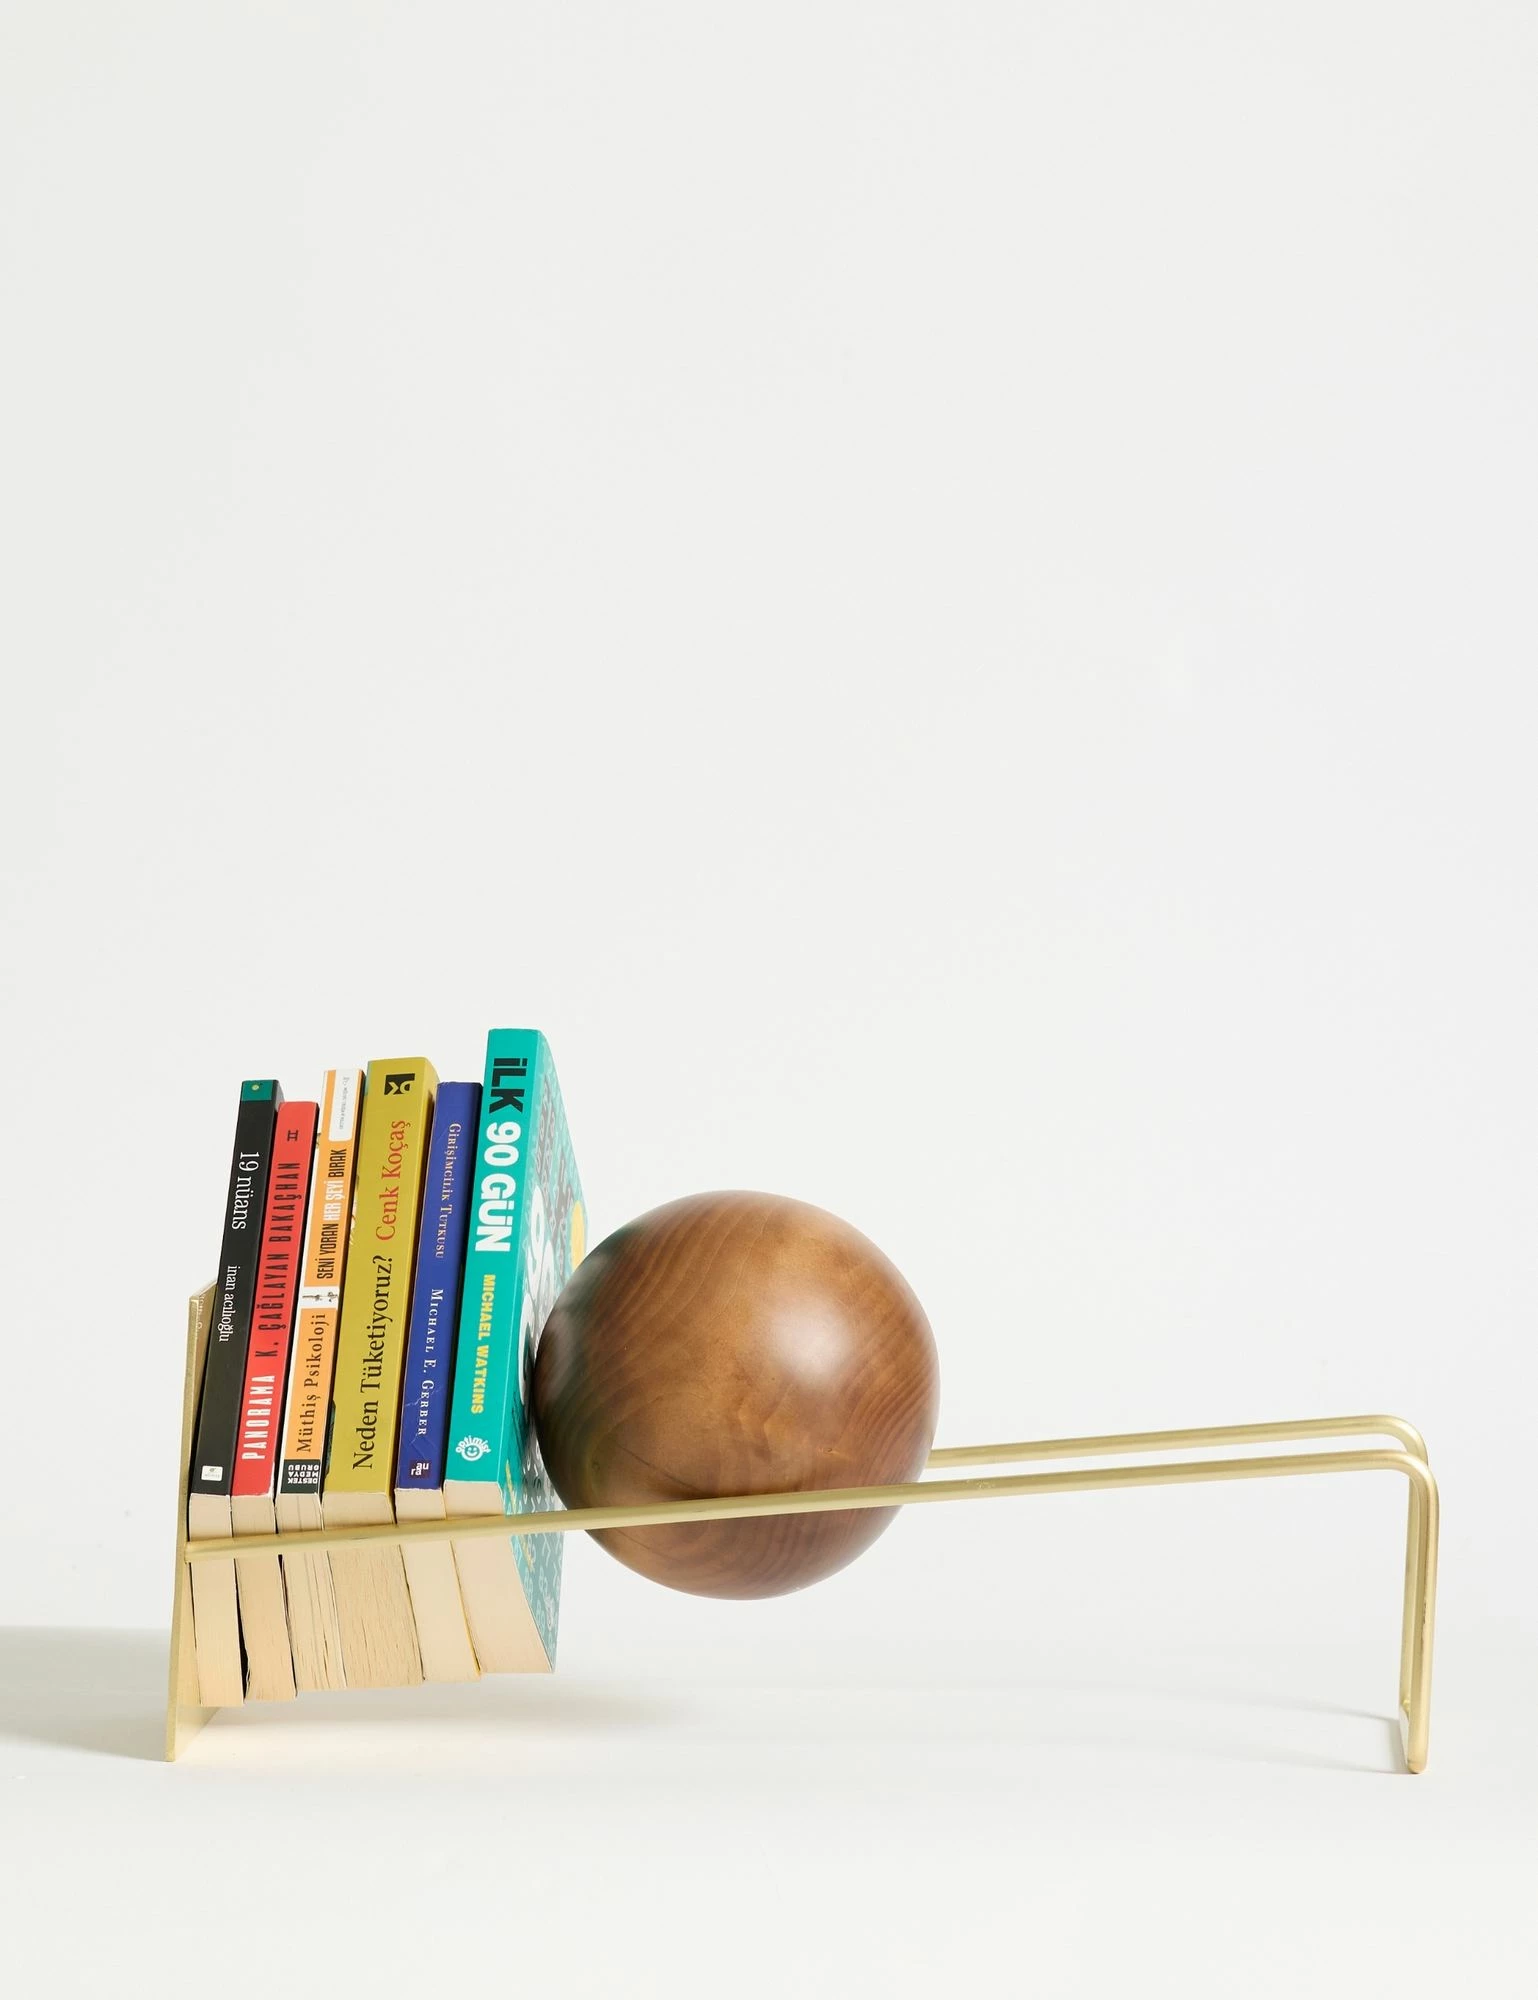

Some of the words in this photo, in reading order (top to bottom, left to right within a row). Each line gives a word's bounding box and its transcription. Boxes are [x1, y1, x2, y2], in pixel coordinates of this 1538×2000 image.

[239, 1152, 260, 1171] 19
[287, 1130, 299, 1142] II
[328, 1148, 347, 1178] BIRAK
[381, 1120, 411, 1180] Koçaş
[484, 1122, 521, 1166] 90
[232, 1176, 254, 1230] nüans
[269, 1163, 302, 1242] BAKAÇHAN
[323, 1202, 341, 1222] HER
[325, 1180, 345, 1200] ŞEYİ
[375, 1186, 400, 1241] Cenk
[475, 1173, 516, 1252] GÜN
[319, 1223, 339, 1256] YORAN
[226, 1265, 241, 1291] inan
[257, 1253, 289, 1330] ÇAĞLAYAN
[315, 1258, 335, 1279] SENİ
[360, 1255, 393, 1393] Tüketiyoruz?
[478, 1274, 496, 1341] MICHAEL
[255, 1342, 279, 1357] K.
[304, 1314, 330, 1387] Psikoloji
[423, 1359, 436, 1373] E.
[471, 1345, 489, 1414] WATKINS
[241, 1375, 275, 1459] PANORAMA
[297, 1394, 321, 1452] Müthiş
[352, 1400, 379, 1469] Neden
[455, 1435, 491, 1453] optimist
